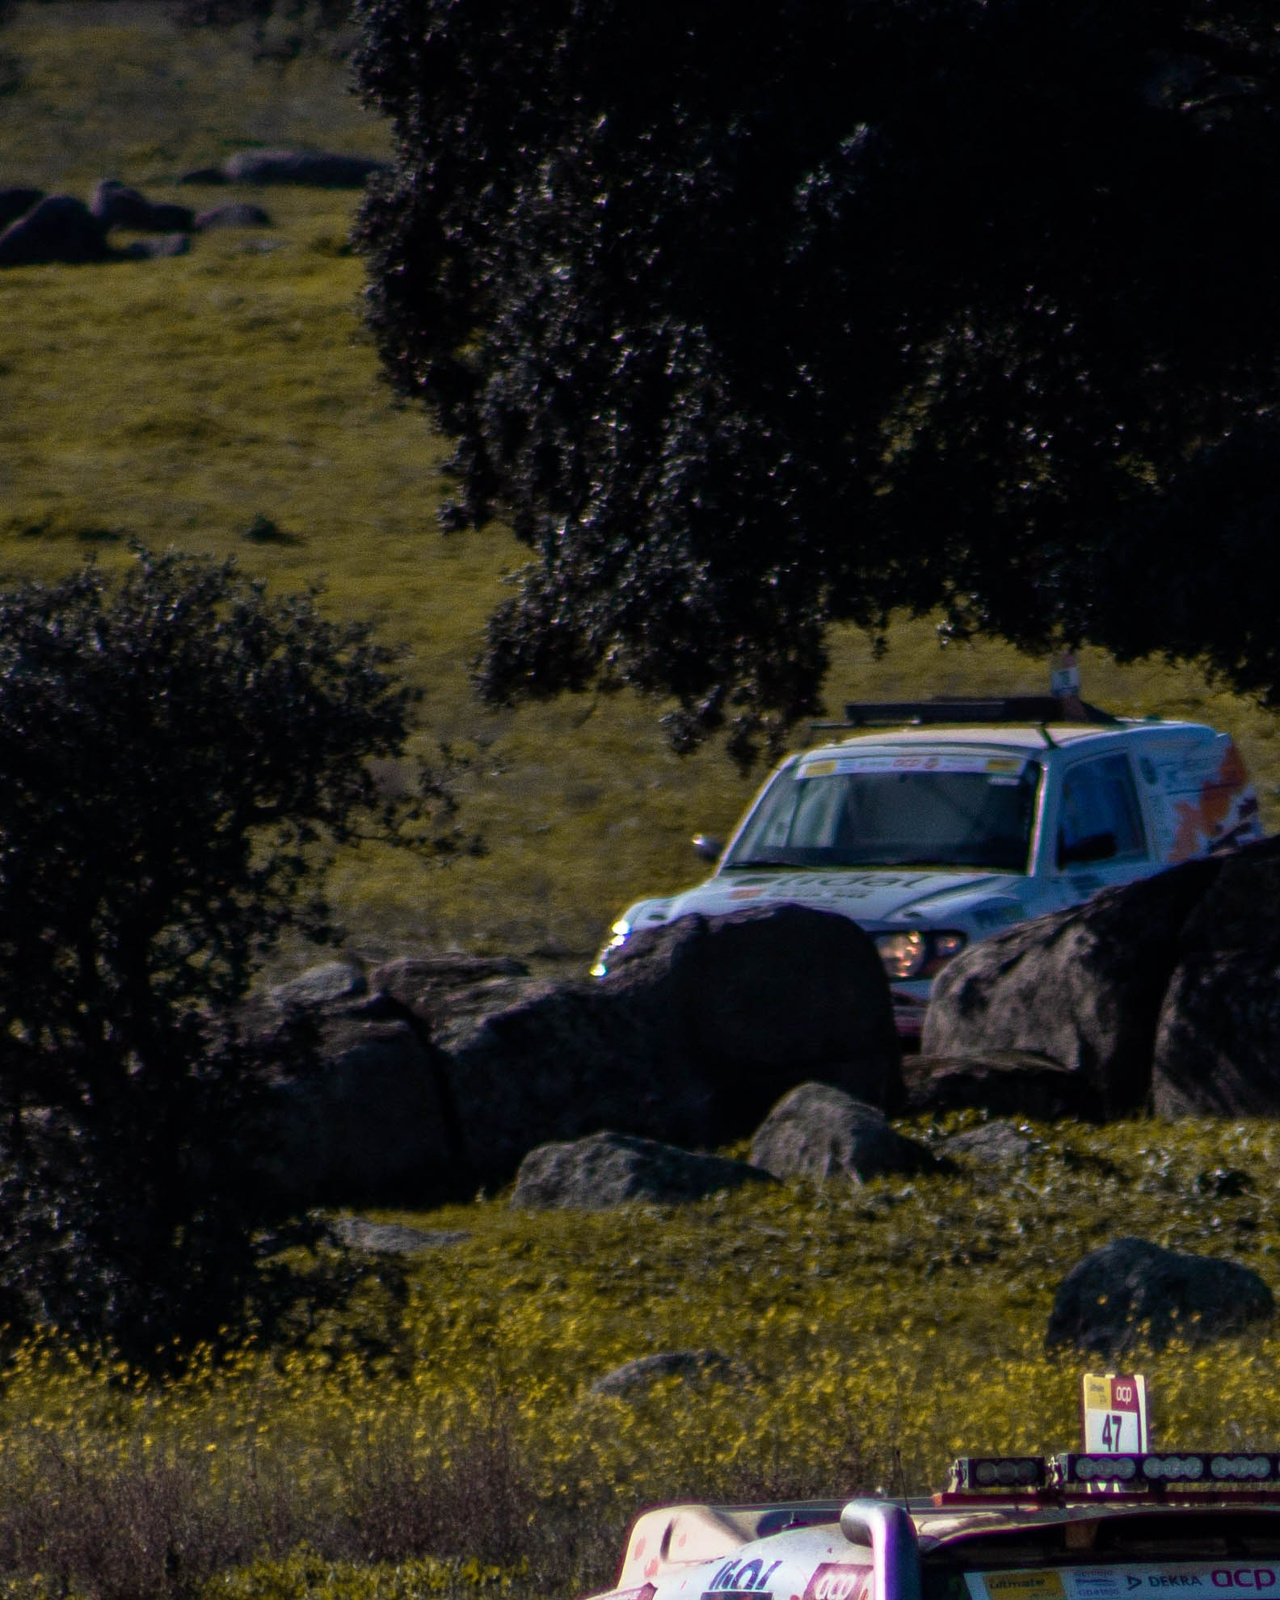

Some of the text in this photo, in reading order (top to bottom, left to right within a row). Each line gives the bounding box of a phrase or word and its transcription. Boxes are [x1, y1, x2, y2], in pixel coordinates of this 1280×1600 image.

[1116, 1386, 1132, 1405] acp
[1102, 1414, 1122, 1452] 47
[1148, 1575, 1202, 1588] DEKRA
[1211, 1567, 1276, 1590] acp
